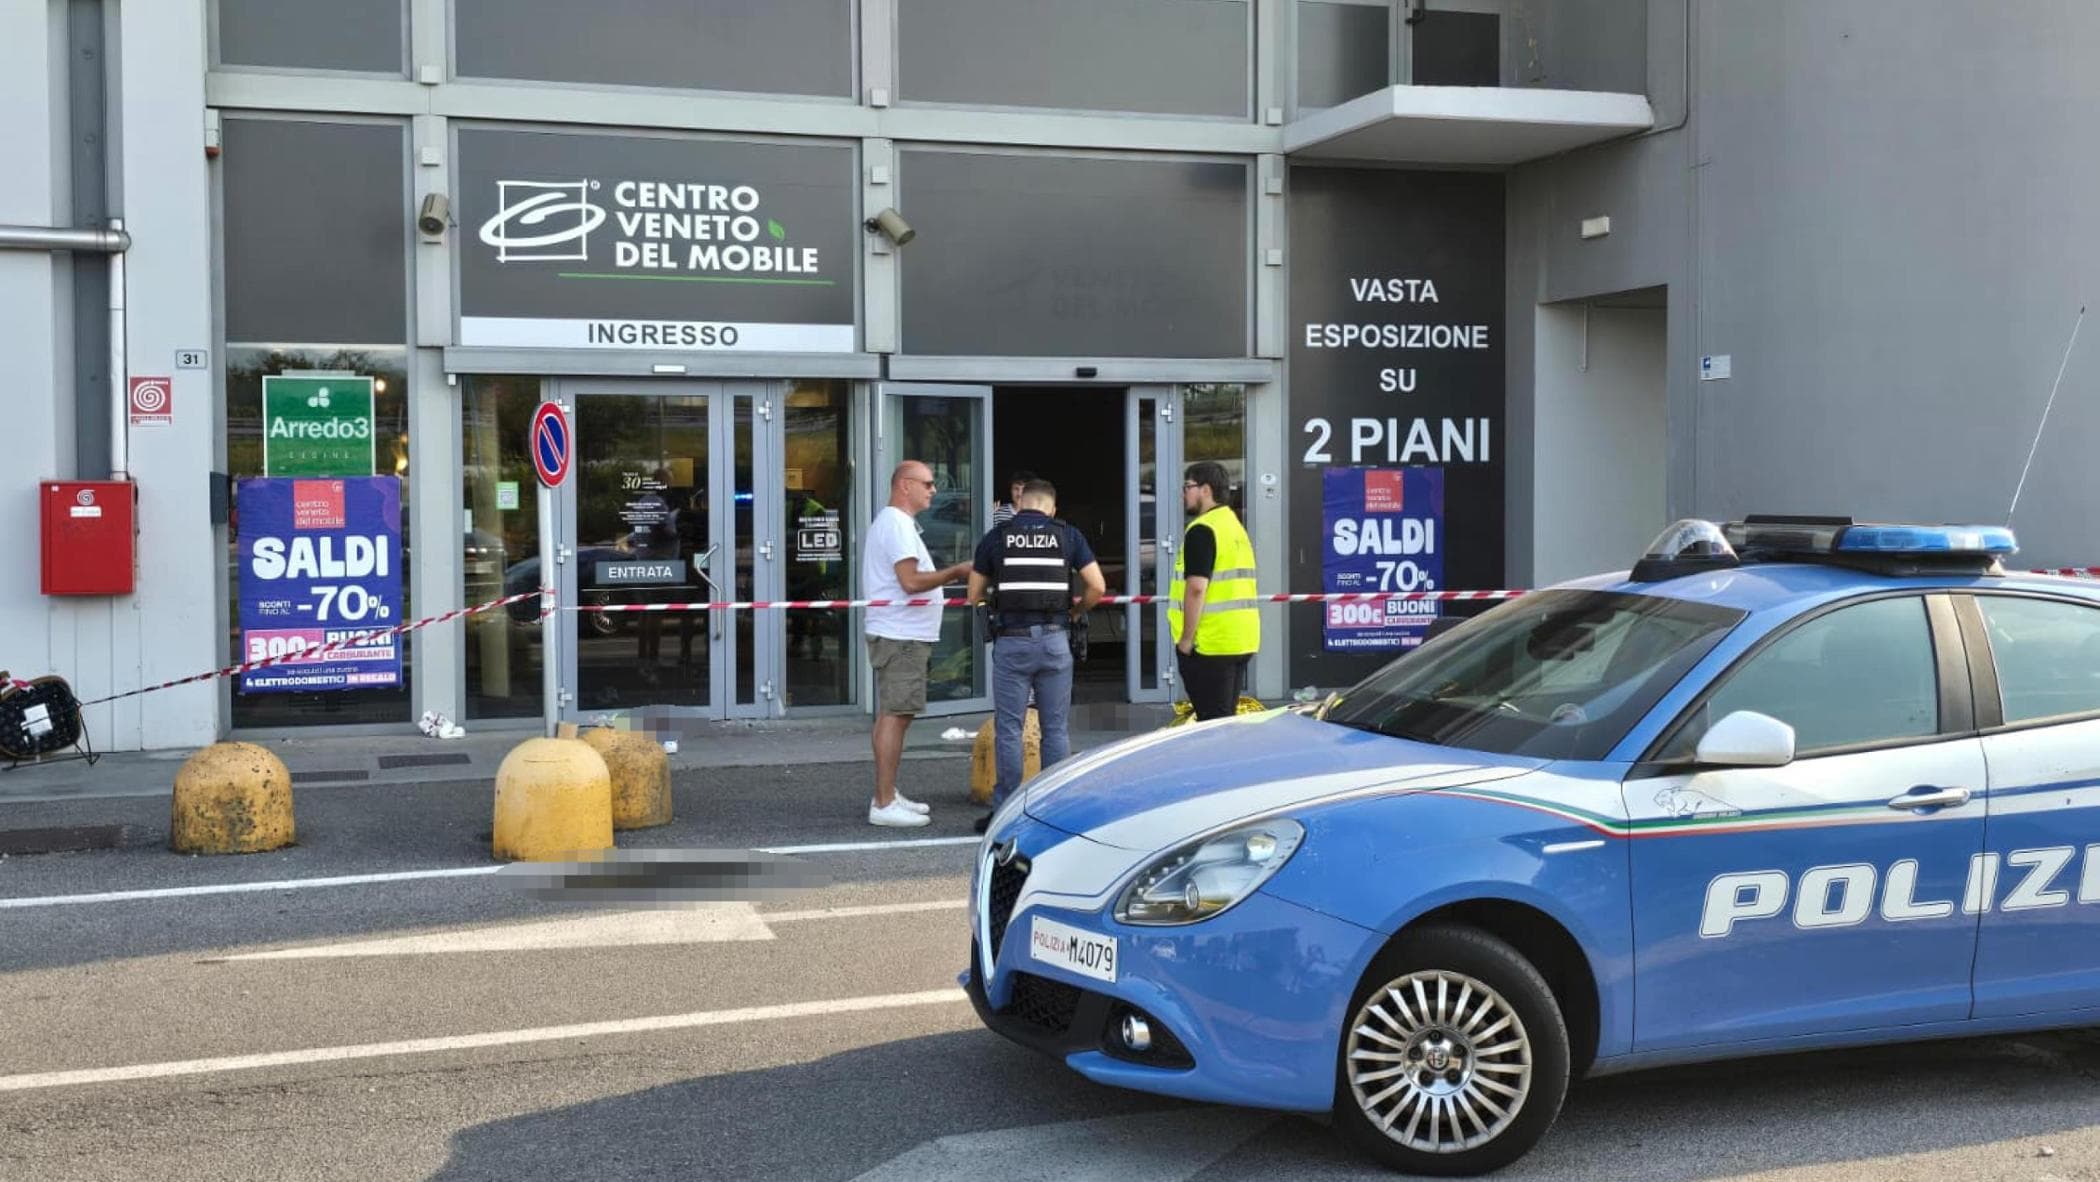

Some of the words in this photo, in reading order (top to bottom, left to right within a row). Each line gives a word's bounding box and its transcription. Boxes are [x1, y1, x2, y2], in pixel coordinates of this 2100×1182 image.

[614, 181, 760, 212] CENTRO
[614, 211, 760, 241] VENETO
[615, 241, 678, 269] DEL
[688, 244, 819, 272] MOBILE
[1350, 278, 1440, 302] VASTA
[588, 322, 739, 347] INGRESSO
[1305, 323, 1490, 348] ESPOSIZIONE
[182, 353, 198, 365] 31
[1379, 368, 1417, 392] SU
[269, 416, 370, 439] Arredo3
[1303, 418, 1332, 462] 2
[1351, 417, 1490, 462] PIANI
[801, 533, 838, 548] LED
[1006, 534, 1059, 548] POLIZIA
[1333, 518, 1434, 556] SALDI
[252, 535, 388, 580] SALDI
[608, 565, 673, 578] ENTRATA
[1365, 560, 1434, 592] -70%
[296, 584, 390, 621] -70%
[1329, 604, 1382, 625] 300€
[1386, 599, 1436, 614] BUONI
[1033, 931, 1066, 954] POLIZIA
[1069, 934, 1114, 972] M4079
